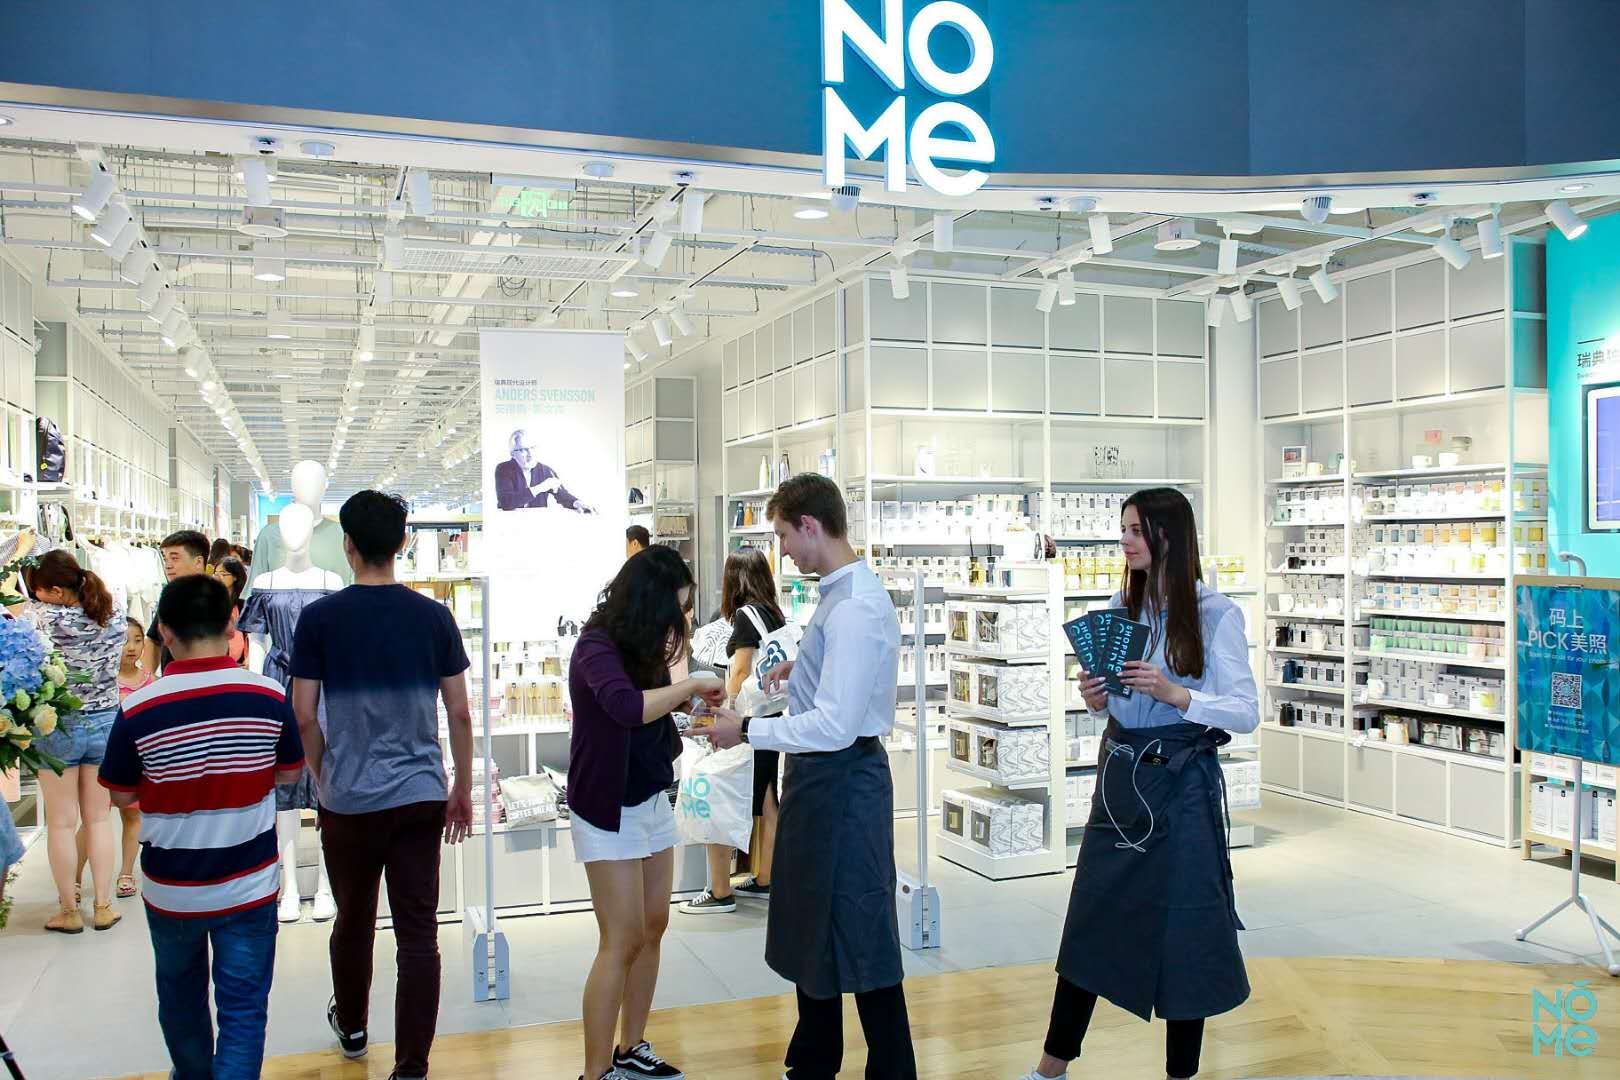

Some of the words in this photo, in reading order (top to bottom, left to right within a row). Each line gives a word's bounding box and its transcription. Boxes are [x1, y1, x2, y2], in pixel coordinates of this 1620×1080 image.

[822, 86, 996, 196] Me
[495, 388, 537, 401] ANDERS
[540, 389, 595, 402] SVENSSON
[1550, 608, 1584, 628] 码上
[1114, 624, 1133, 673] SHOPPING
[1528, 629, 1607, 655] PICK美照
